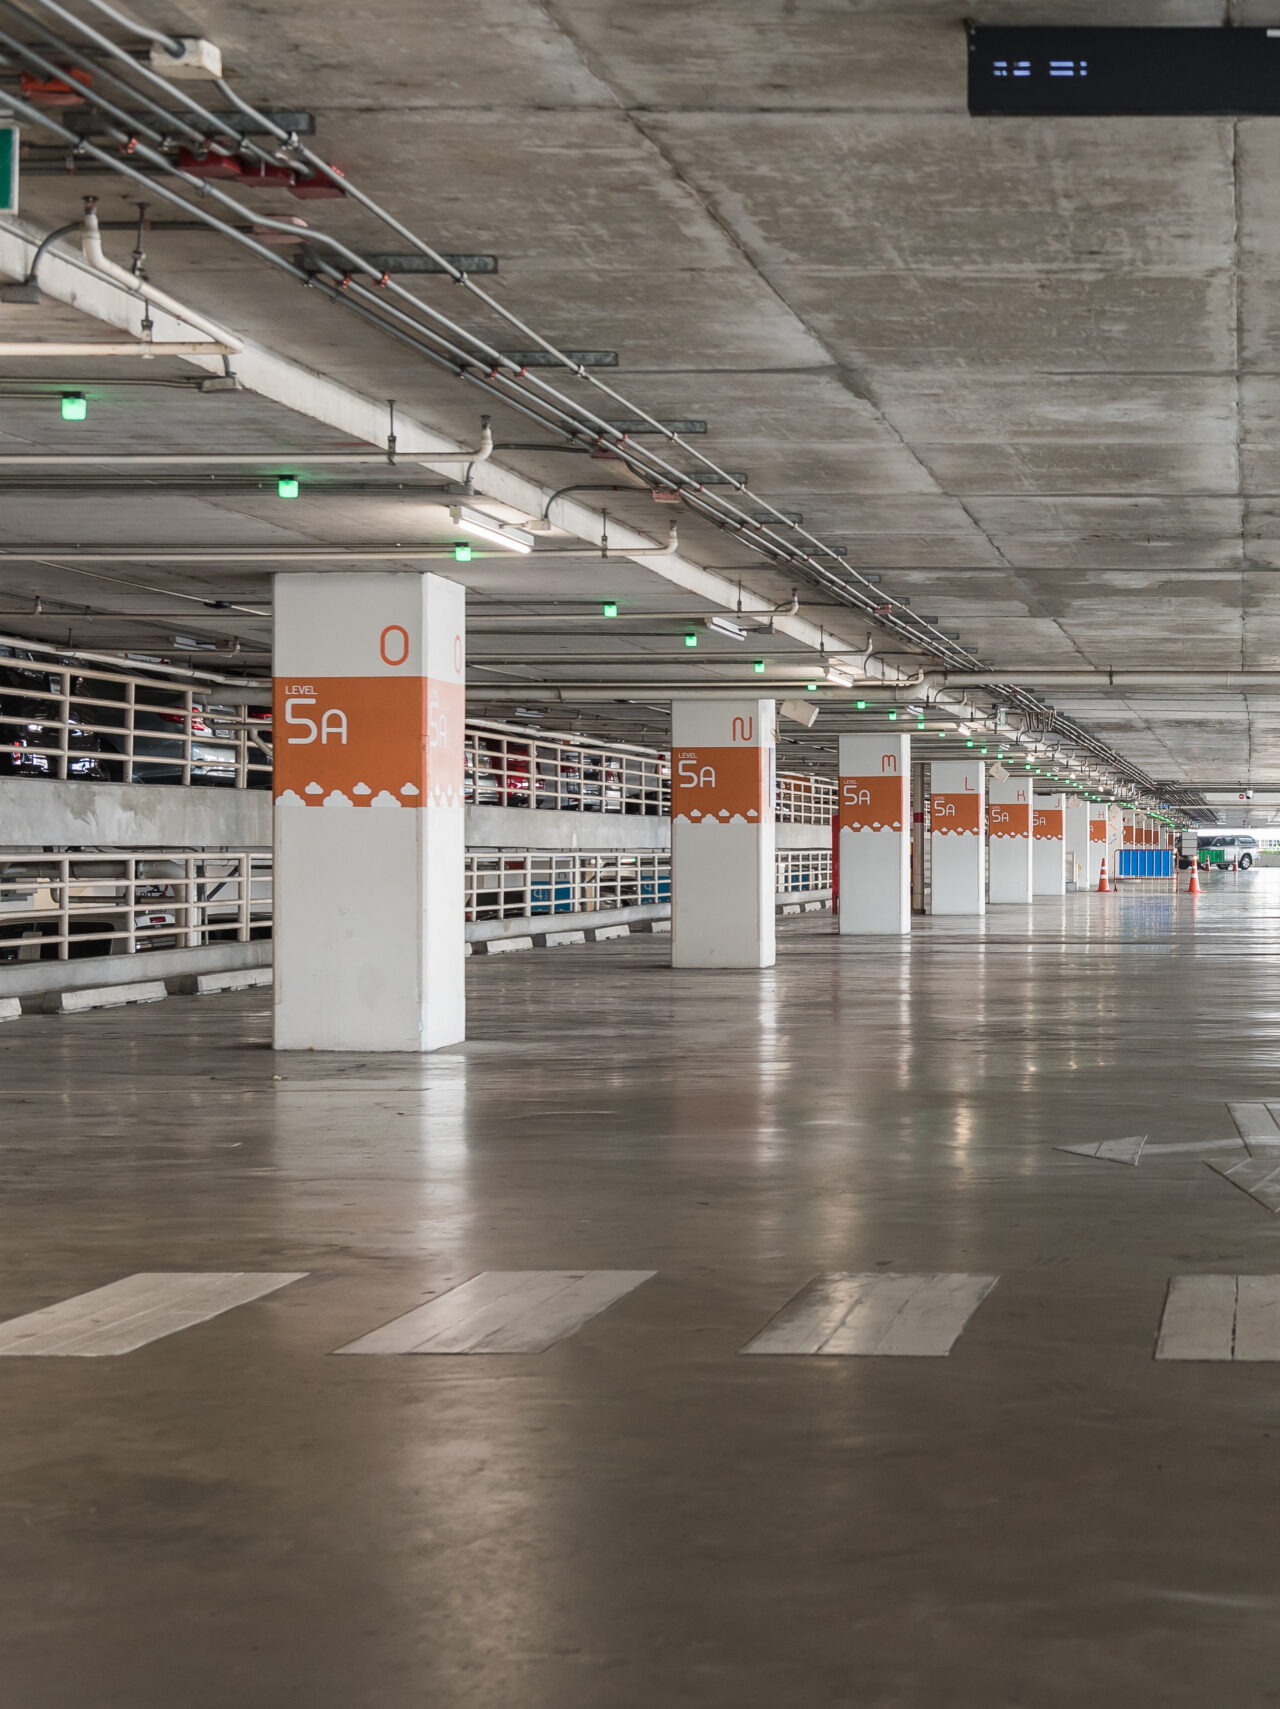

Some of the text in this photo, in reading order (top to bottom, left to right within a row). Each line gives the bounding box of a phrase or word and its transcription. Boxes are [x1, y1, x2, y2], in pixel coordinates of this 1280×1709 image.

[285, 686, 318, 695] LEVEL
[285, 698, 347, 744] 5A
[732, 716, 753, 742] N
[881, 754, 897, 773] M
[678, 760, 716, 788] 5A
[964, 777, 975, 791] L
[844, 785, 870, 805] 5A
[934, 801, 955, 816] 5A
[991, 810, 1009, 822] 5A
